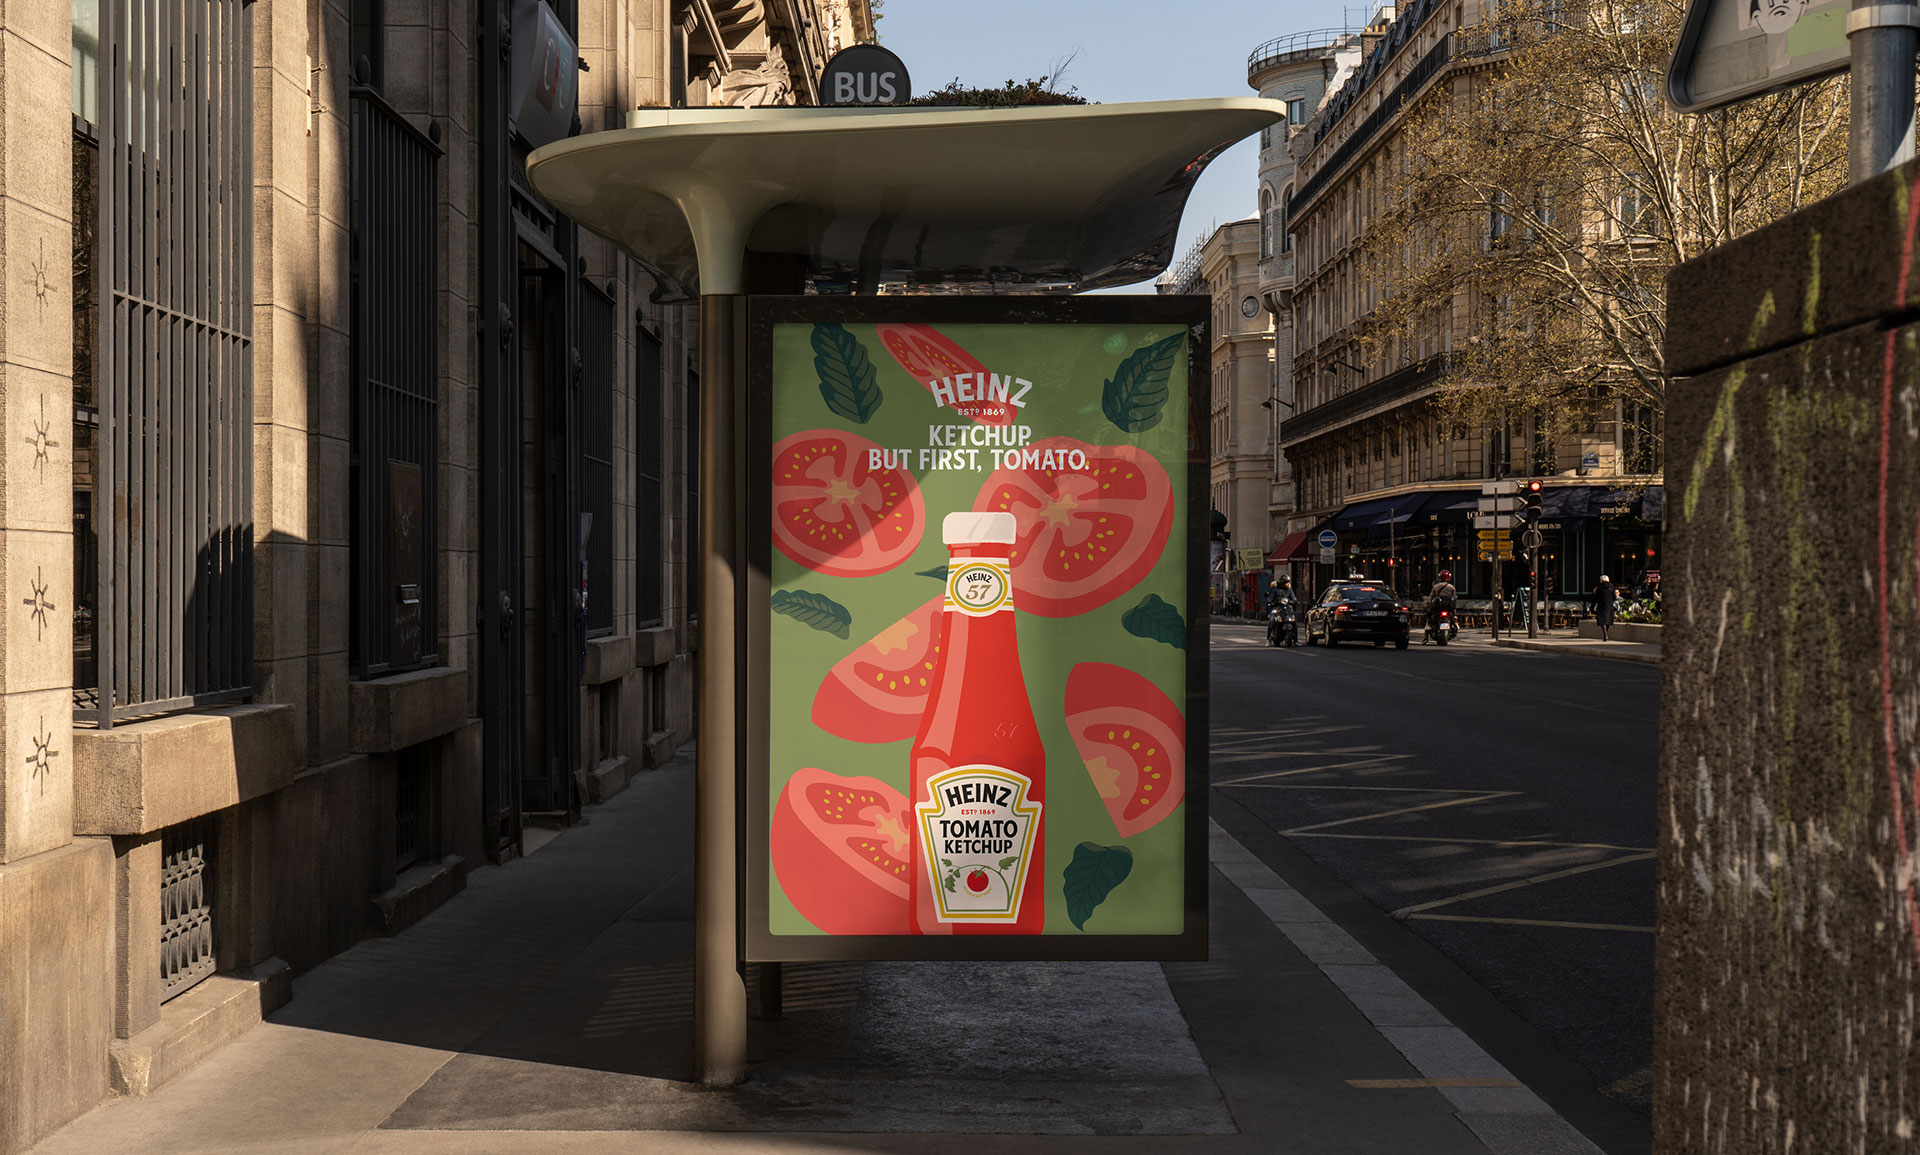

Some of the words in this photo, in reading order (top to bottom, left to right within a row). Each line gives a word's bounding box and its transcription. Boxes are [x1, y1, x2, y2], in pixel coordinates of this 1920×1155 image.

[834, 71, 897, 103] BUS
[929, 372, 1033, 409] HEINZ
[982, 408, 1005, 416] 1869
[929, 425, 1032, 447] KETCHUP.
[868, 448, 912, 471] BUT
[919, 448, 983, 473] FIRST,
[990, 448, 1090, 471] TOMATO.
[966, 573, 993, 584] HEINZ
[965, 584, 992, 601] 57
[945, 783, 1012, 808] HEINZ
[939, 820, 1018, 838] TOMATO
[944, 839, 1013, 854] KETCHUP
